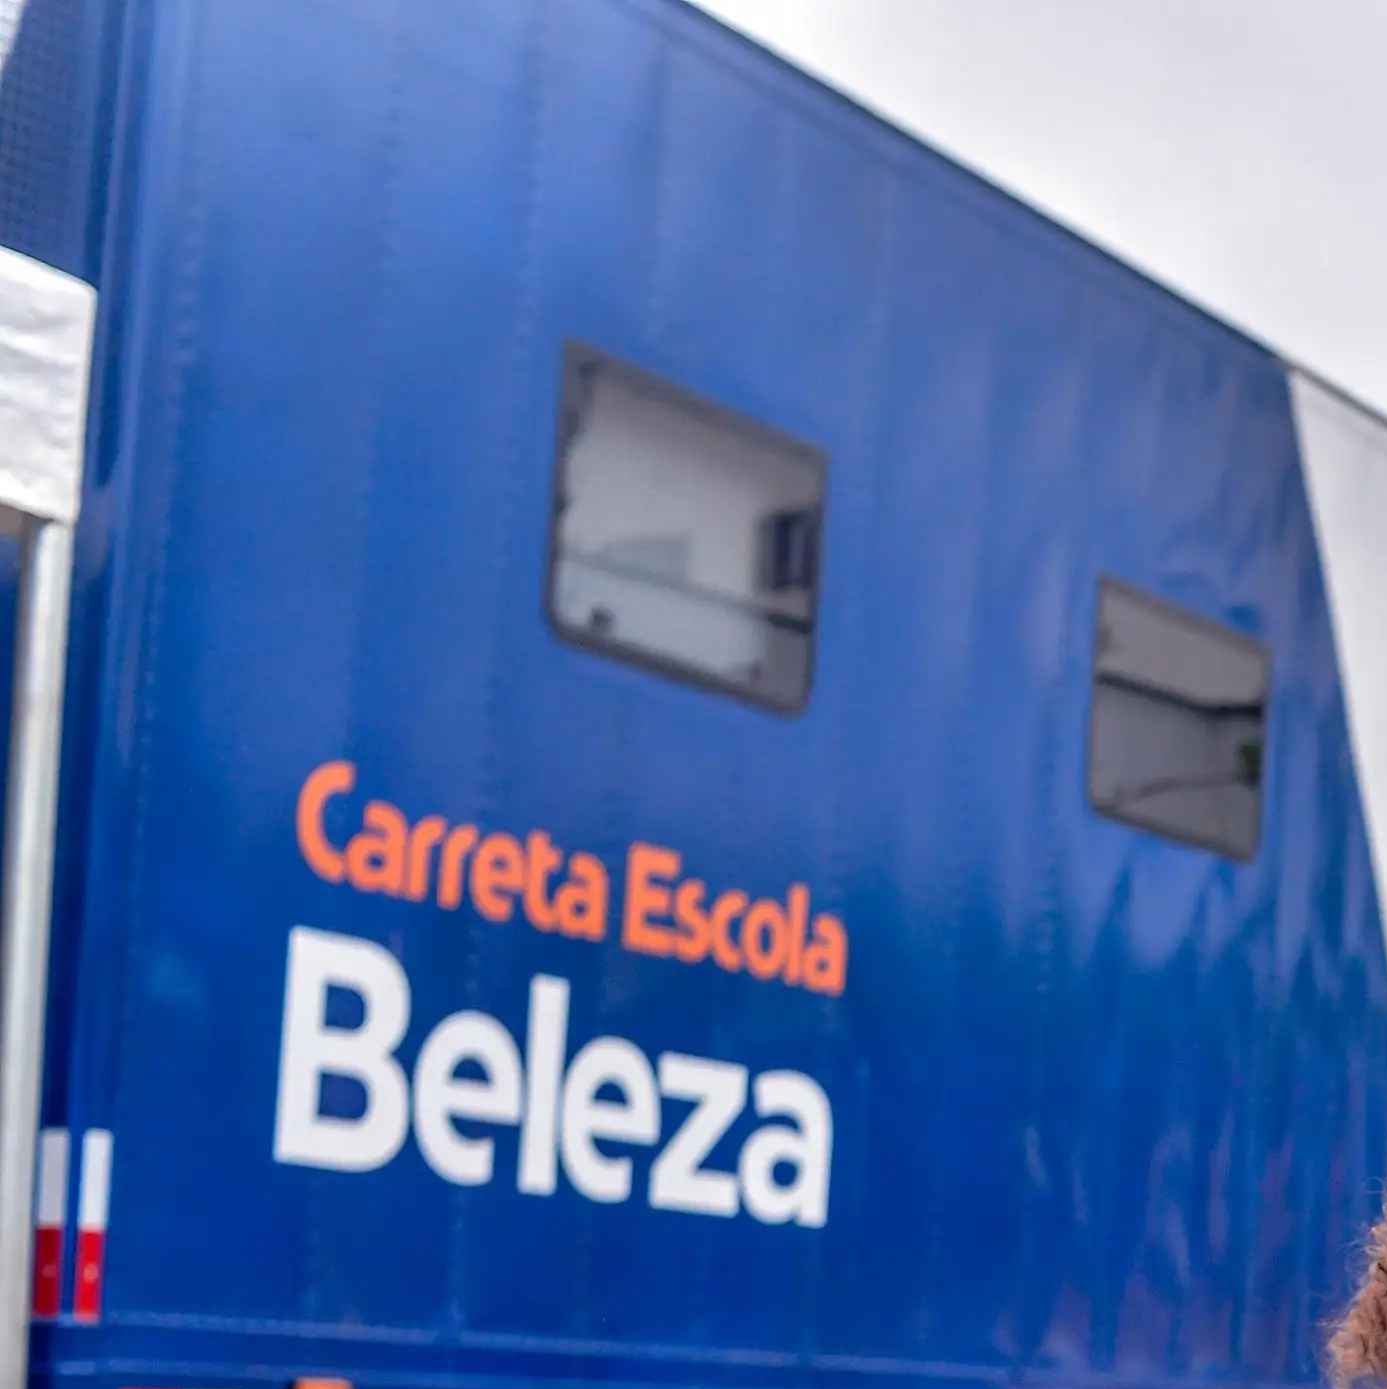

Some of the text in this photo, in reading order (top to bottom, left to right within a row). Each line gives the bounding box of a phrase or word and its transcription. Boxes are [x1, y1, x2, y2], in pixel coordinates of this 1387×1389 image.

[296, 762, 847, 996] Carreta Escola
[273, 926, 833, 1228] Beleza
